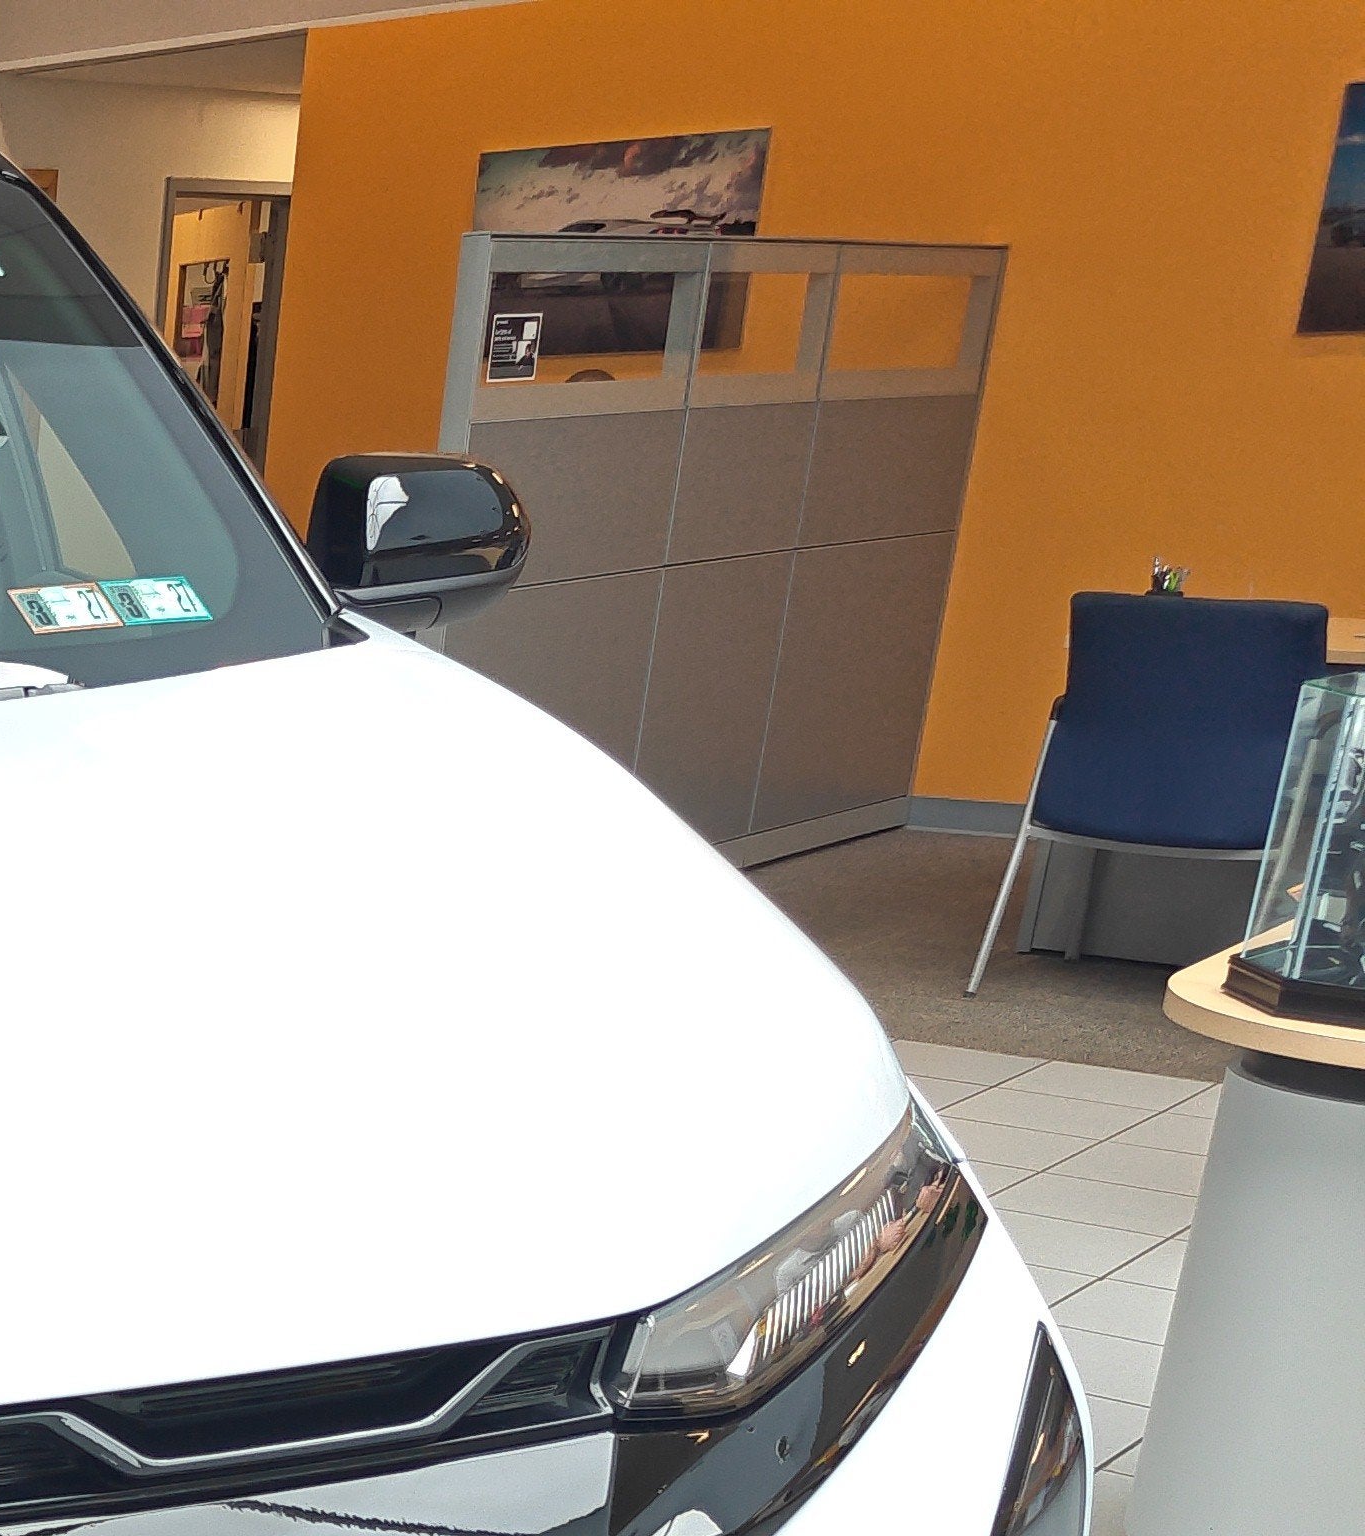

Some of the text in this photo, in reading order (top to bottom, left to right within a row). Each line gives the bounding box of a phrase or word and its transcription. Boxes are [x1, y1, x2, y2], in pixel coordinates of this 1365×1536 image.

[27, 589, 109, 625] 3 27
[120, 583, 198, 618] 3 27
